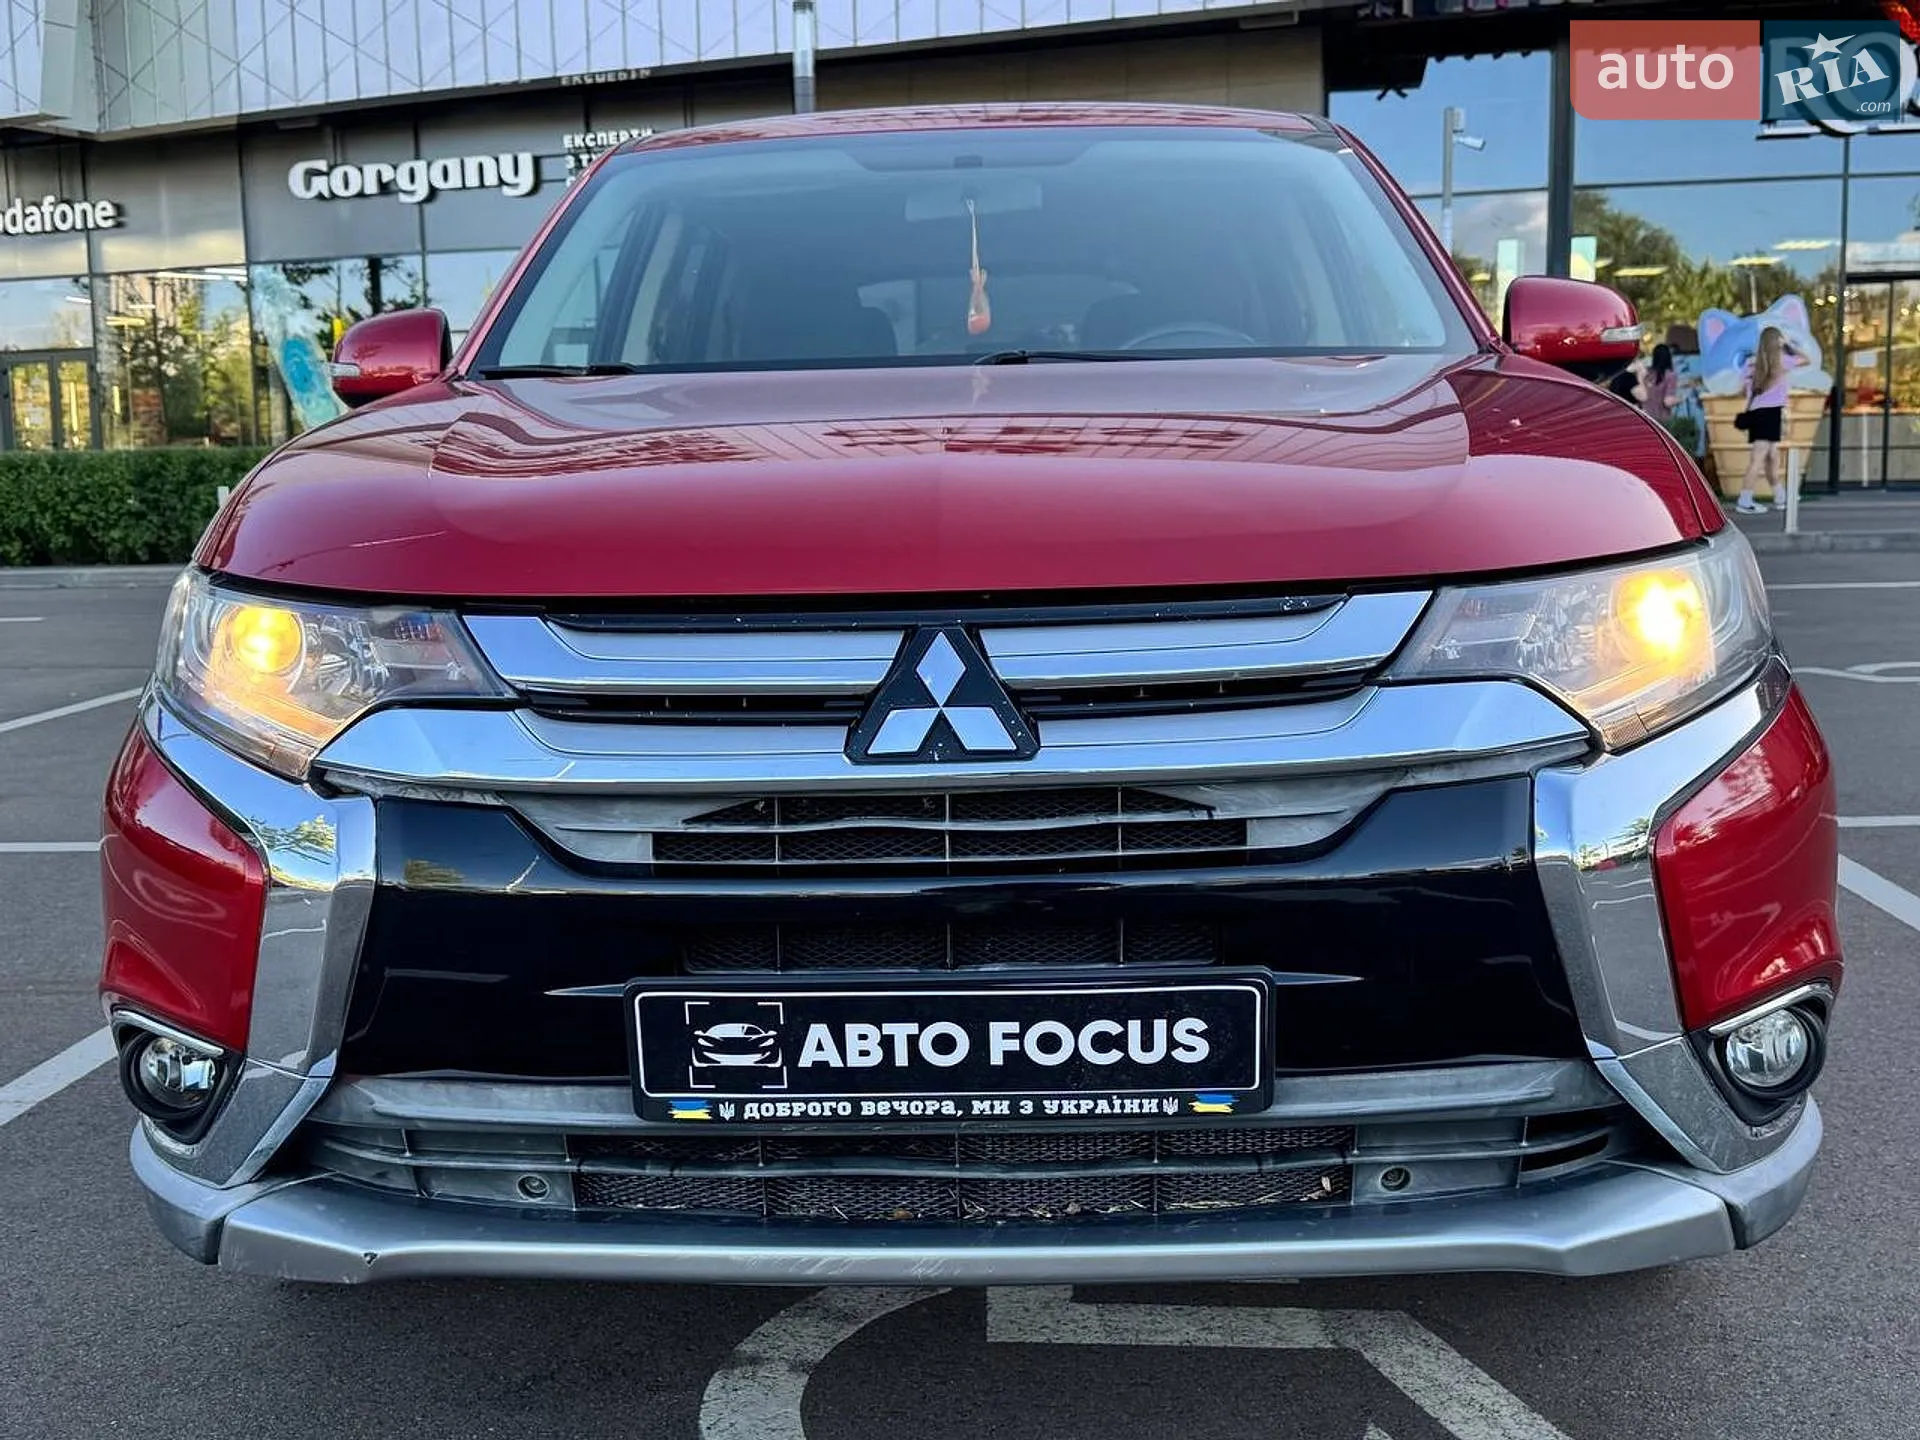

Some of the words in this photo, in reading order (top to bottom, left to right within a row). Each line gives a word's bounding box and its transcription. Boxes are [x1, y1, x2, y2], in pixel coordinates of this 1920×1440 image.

[288, 152, 535, 204] Gorgany
[0, 195, 117, 235] dafone
[798, 1022, 971, 1068] АВТО
[989, 1017, 1210, 1067] FOCUS
